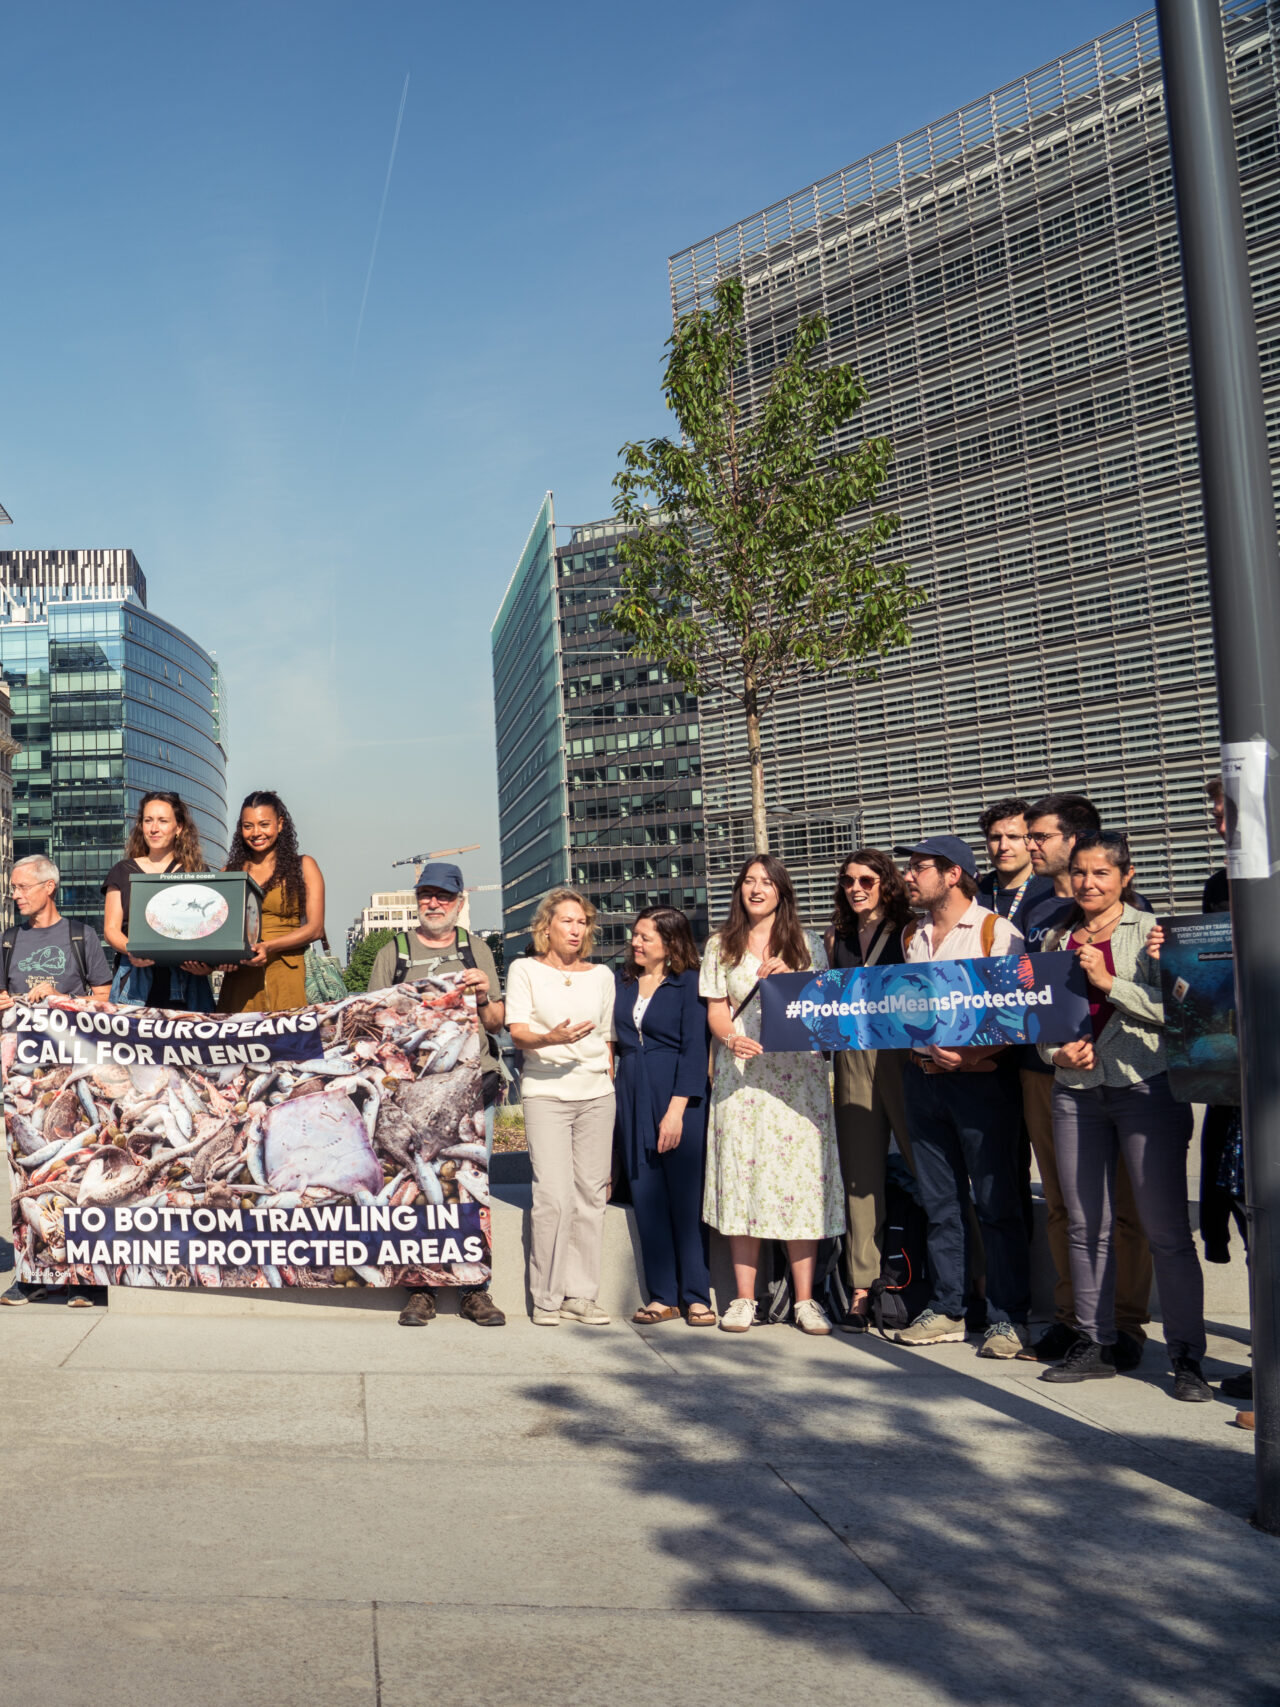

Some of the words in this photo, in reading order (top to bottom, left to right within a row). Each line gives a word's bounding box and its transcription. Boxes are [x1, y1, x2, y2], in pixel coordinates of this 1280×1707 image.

[785, 984, 1053, 1019] #ProtectedMeansProtected
[16, 1008, 130, 1037] 250,000
[137, 1011, 319, 1040] EUROPEANS
[17, 1039, 89, 1065] CALL
[96, 1041, 156, 1066] FOR
[162, 1043, 206, 1066] AN
[207, 1043, 271, 1065] END
[64, 1207, 106, 1232] TO
[115, 1207, 244, 1232] BOTTOM
[249, 1205, 418, 1232] TRAWLING
[426, 1203, 460, 1230] IN
[66, 1240, 180, 1265] MARINE
[188, 1240, 368, 1266] PROTECTED
[376, 1237, 484, 1265] AREAS
